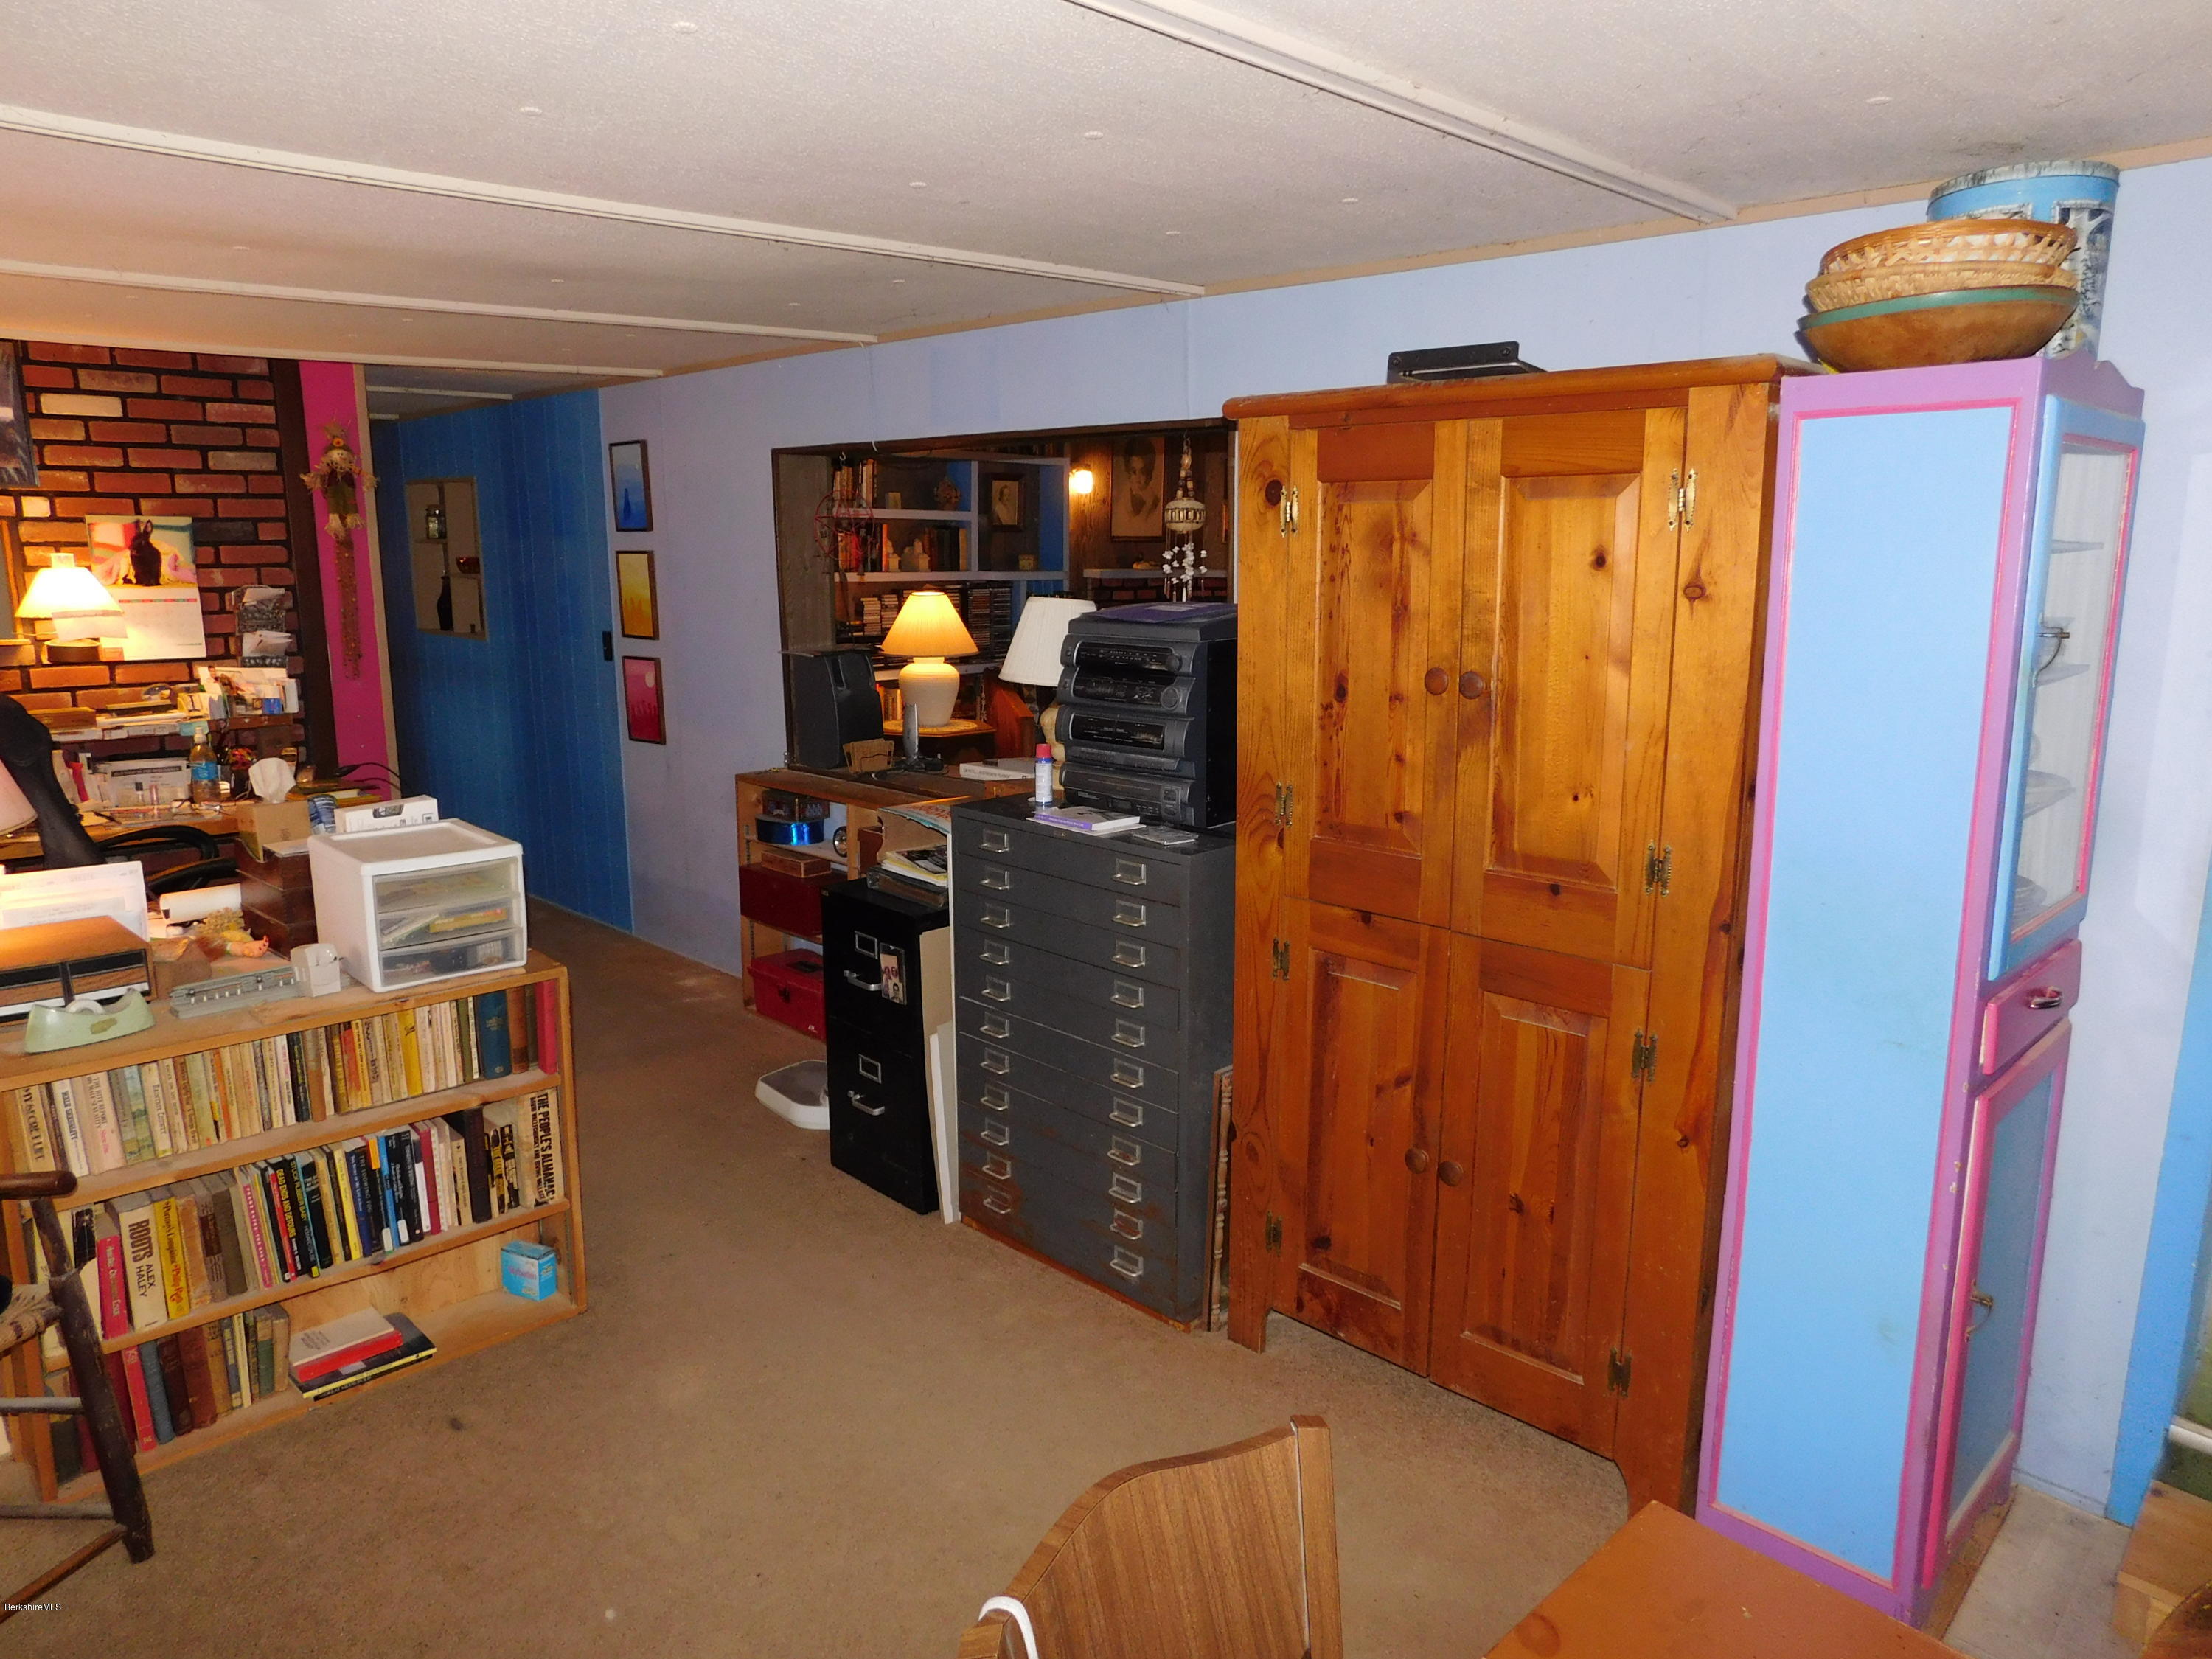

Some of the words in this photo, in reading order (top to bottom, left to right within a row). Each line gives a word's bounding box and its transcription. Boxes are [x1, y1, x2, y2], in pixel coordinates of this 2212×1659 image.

[21, 1088, 34, 1102] MY
[537, 1092, 548, 1109] THE
[538, 1111, 552, 1152] PEOPLE'S
[276, 1169, 285, 1185] DEAD
[542, 1153, 554, 1196] ALMANAC
[279, 1184, 289, 1200] ENDS
[289, 1160, 299, 1180] STUCK
[298, 1206, 307, 1222] BABY
[282, 1200, 291, 1212] AND
[284, 1211, 296, 1238] DETOURS
[128, 1218, 154, 1263] ROOTS
[135, 1265, 147, 1298] HALEY
[145, 1262, 156, 1289] ALEX
